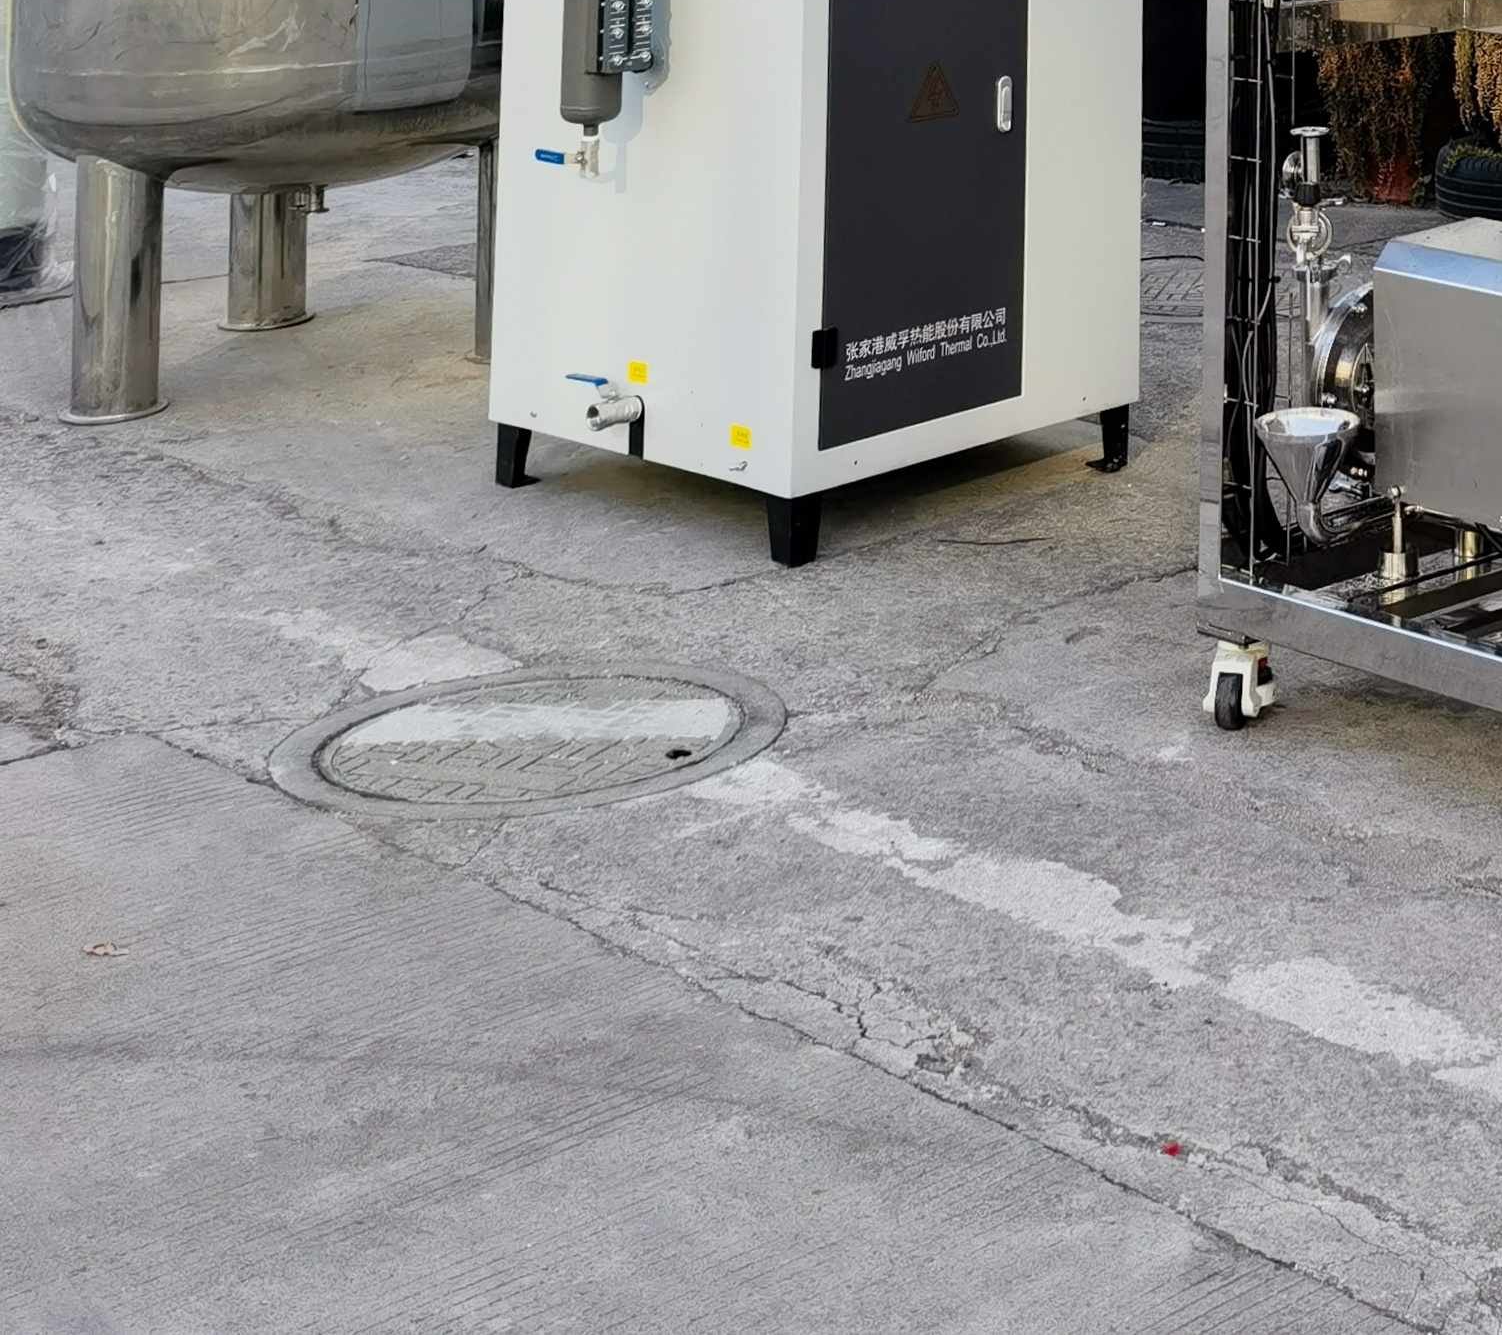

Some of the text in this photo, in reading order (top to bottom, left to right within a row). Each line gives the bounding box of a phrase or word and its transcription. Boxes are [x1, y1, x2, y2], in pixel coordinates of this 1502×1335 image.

[844, 356, 902, 382] Zhangjiagang
[906, 345, 935, 366] Wilford
[940, 335, 973, 357] Thermal
[845, 307, 1007, 362] 张家港威孚热能股份有限公司
